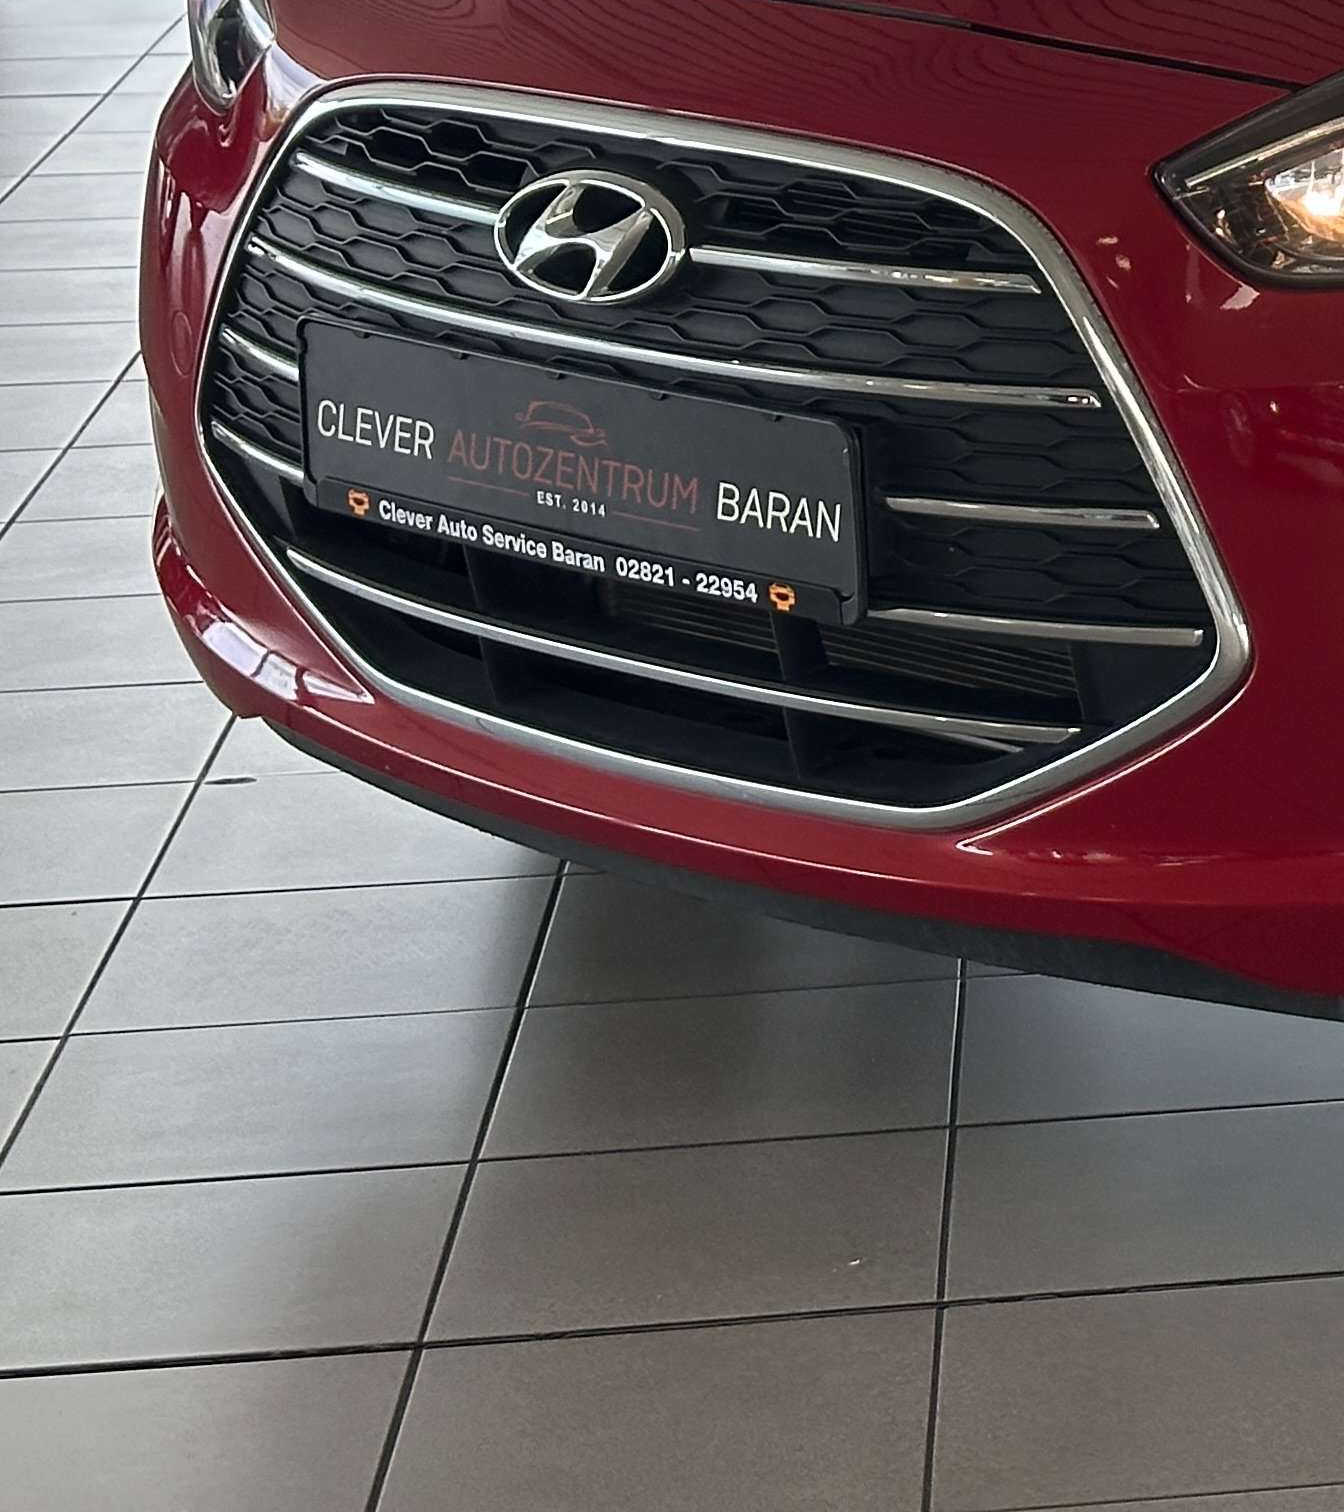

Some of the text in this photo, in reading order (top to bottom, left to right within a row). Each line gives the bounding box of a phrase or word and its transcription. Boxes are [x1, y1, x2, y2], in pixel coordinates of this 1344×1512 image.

[317, 399, 842, 543] CLEVER AUTOZENTRUM BARAN
[536, 490, 607, 518] EST. 2014
[378, 499, 434, 531] Clever
[436, 513, 479, 543] Auto
[481, 524, 548, 559] Service
[551, 540, 606, 574] Baran
[615, 555, 676, 587] 02821
[695, 572, 759, 604] 22954
